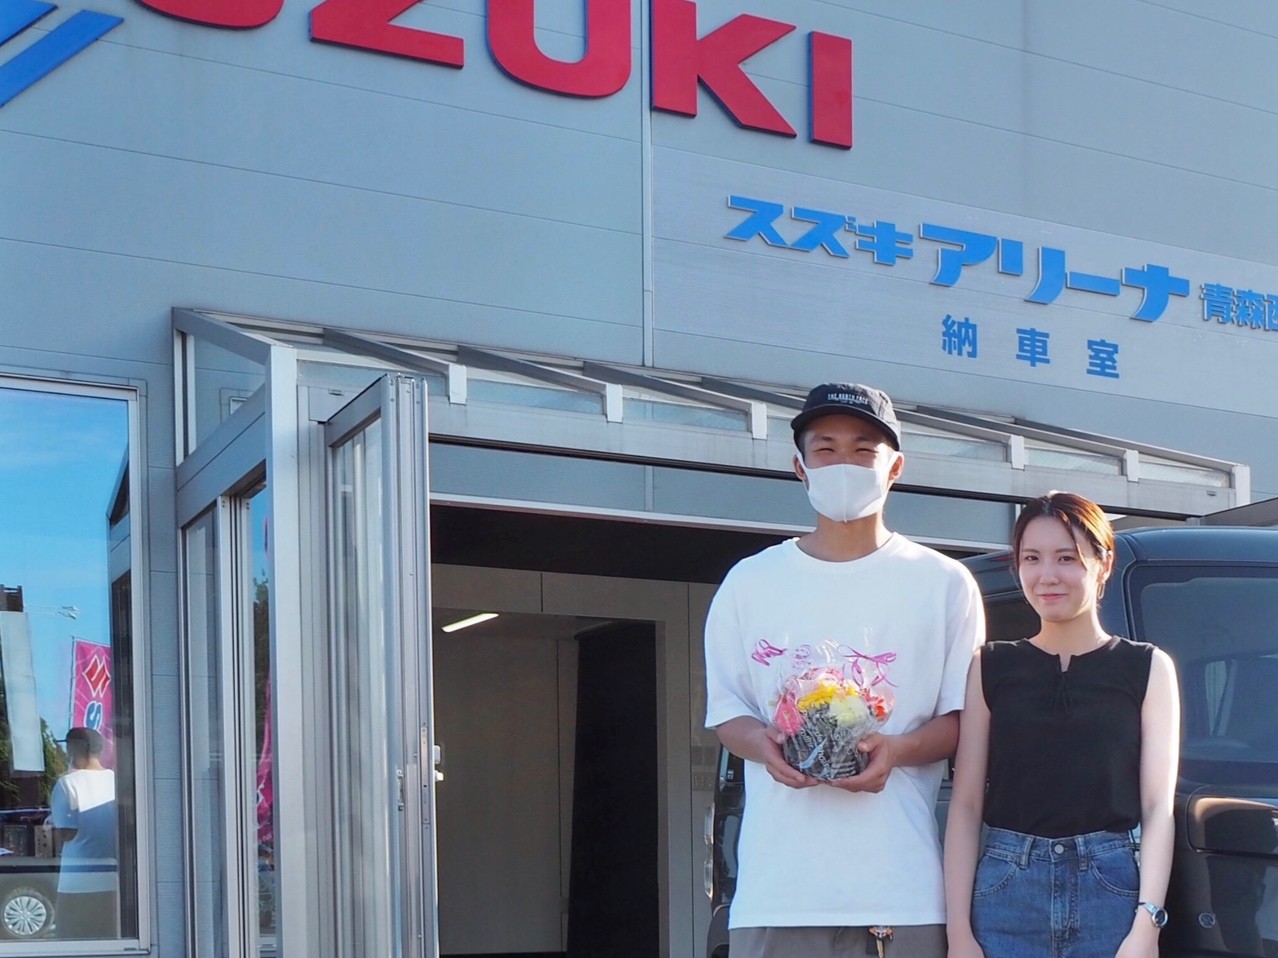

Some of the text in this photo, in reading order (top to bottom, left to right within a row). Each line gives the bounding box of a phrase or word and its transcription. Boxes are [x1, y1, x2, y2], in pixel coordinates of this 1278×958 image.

[137, 0, 853, 149] UKI
[726, 195, 1190, 323] スズキアリーナ
[941, 314, 1120, 380] 納車室
